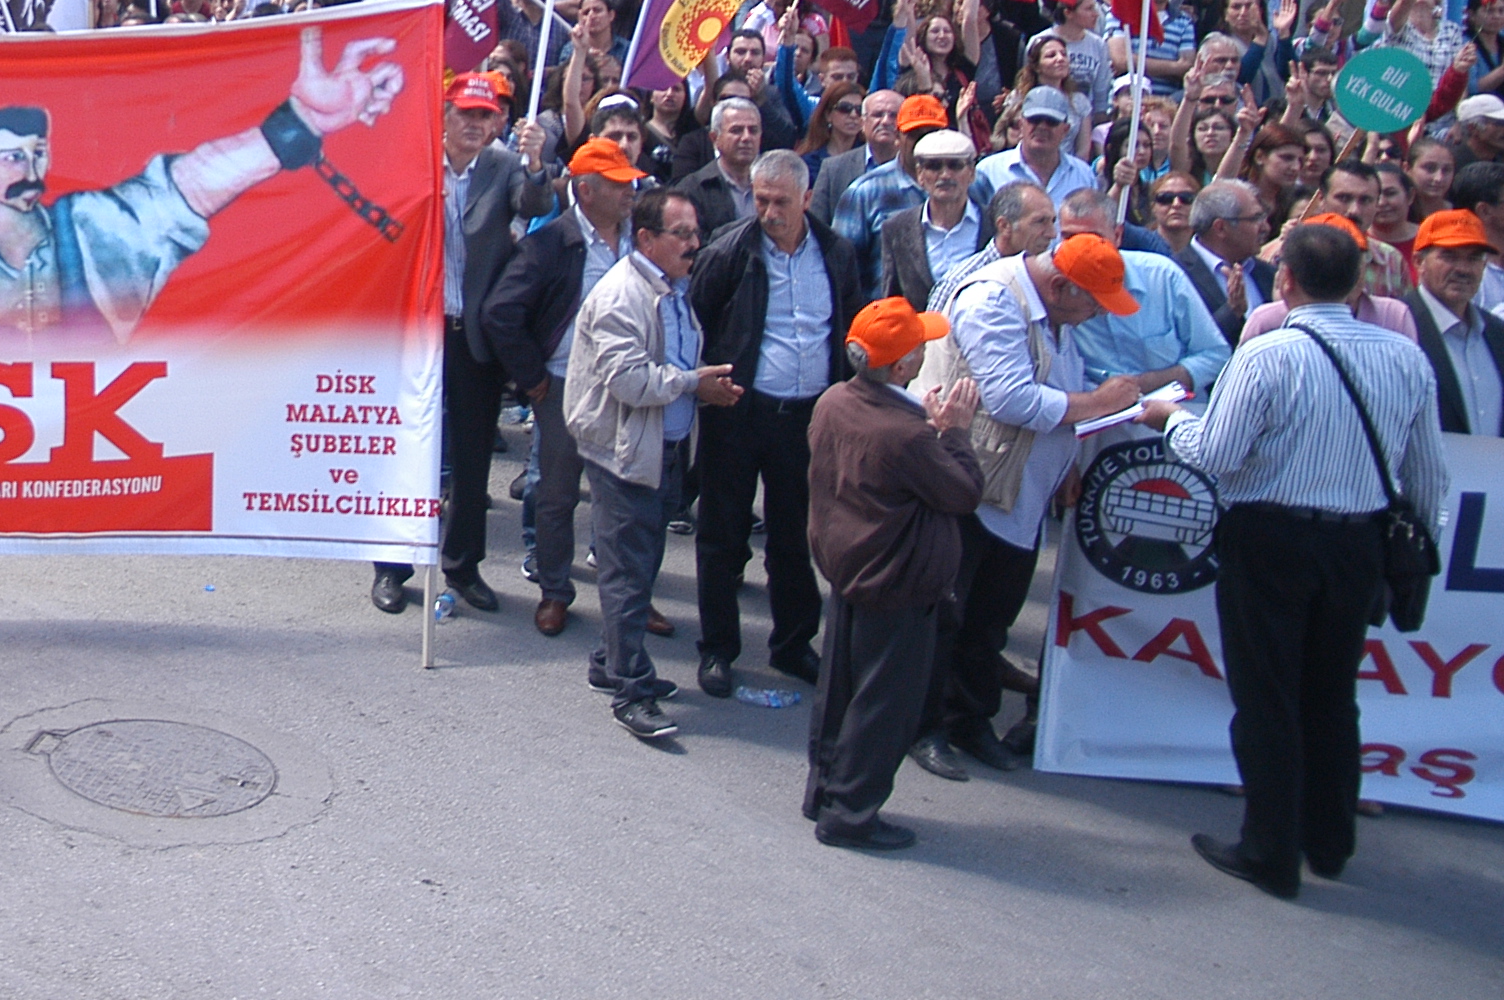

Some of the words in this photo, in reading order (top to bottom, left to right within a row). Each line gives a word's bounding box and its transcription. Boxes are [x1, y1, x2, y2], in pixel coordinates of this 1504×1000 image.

[1369, 89, 1414, 122] GULAN
[315, 369, 377, 394] DİSK
[285, 404, 403, 425] MALATYA
[290, 434, 398, 459] ŞUBELER
[22, 475, 163, 499] KONFEDERASYONU
[328, 468, 359, 484] ve
[1120, 565, 1180, 589] 1963
